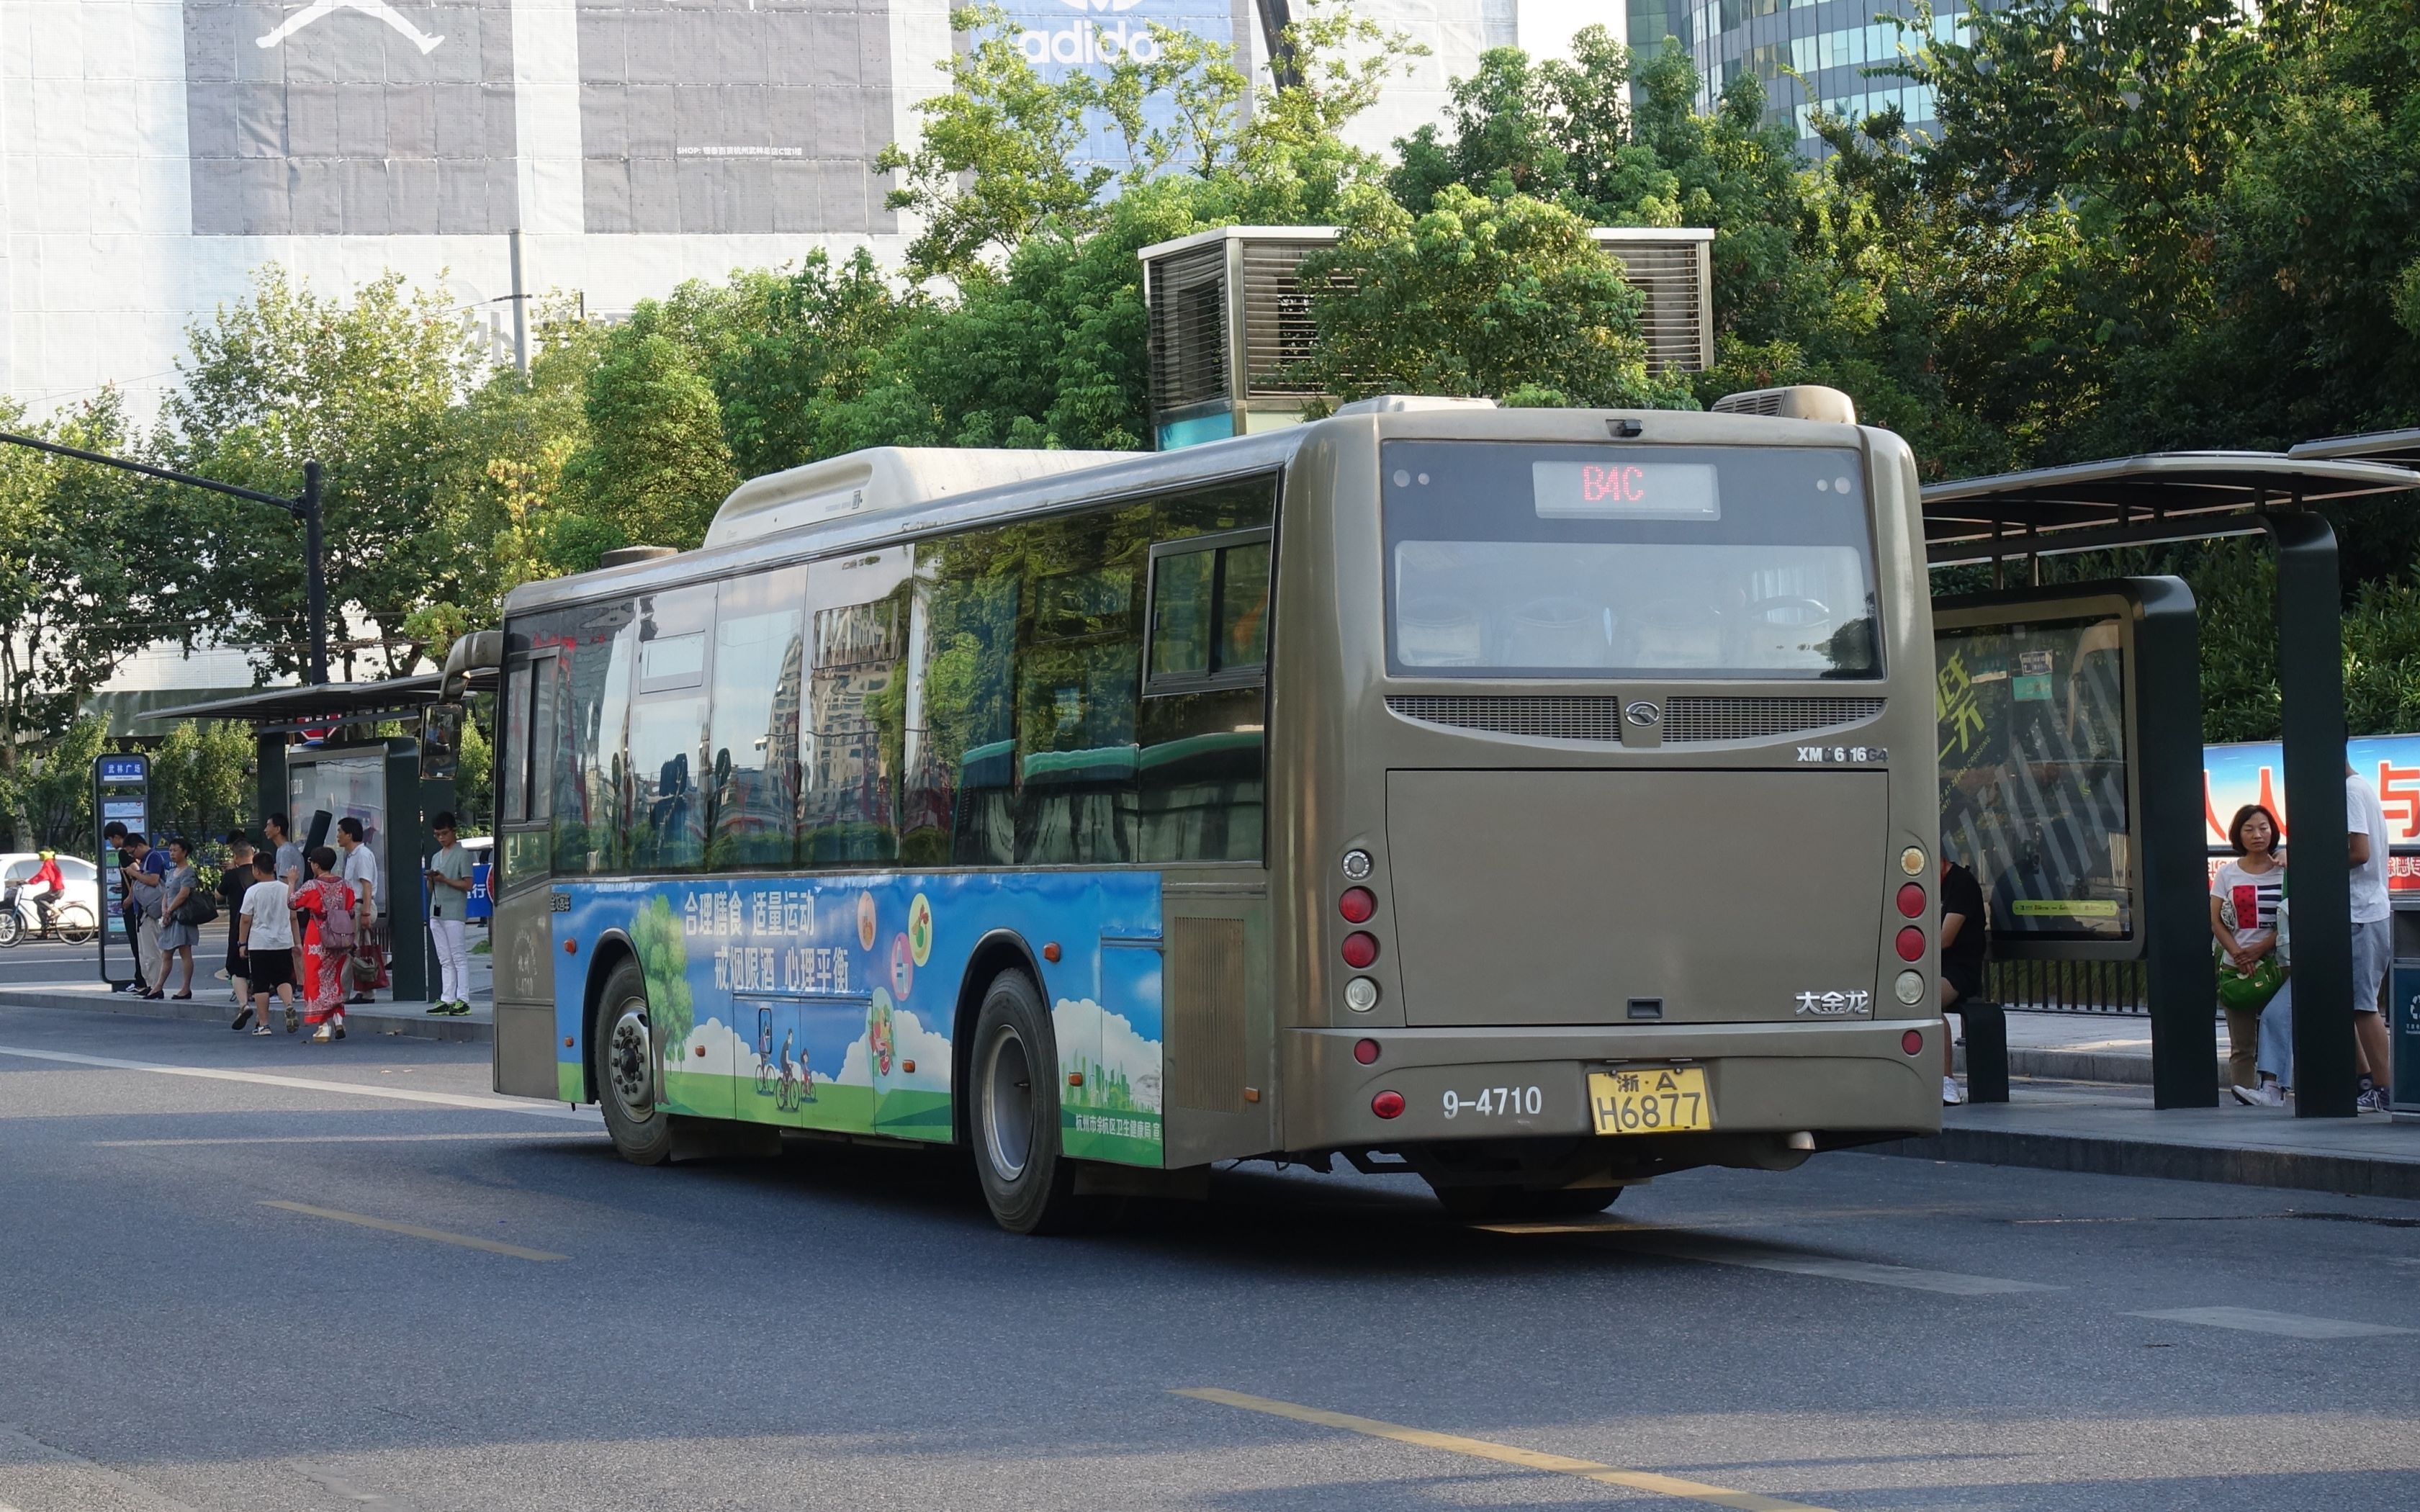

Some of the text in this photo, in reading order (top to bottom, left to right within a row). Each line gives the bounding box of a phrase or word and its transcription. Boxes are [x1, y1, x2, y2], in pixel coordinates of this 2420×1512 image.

[1018, 20, 1161, 65] adida
[1583, 466, 1644, 501] B4C
[685, 889, 814, 936] 合理膳食 适量运动
[714, 945, 849, 993] 戒烟限酒 心理平衡
[1795, 990, 1869, 1015] 大金龙
[1443, 1086, 1542, 1120] 9-4710
[1596, 1092, 1701, 1130] H6877
